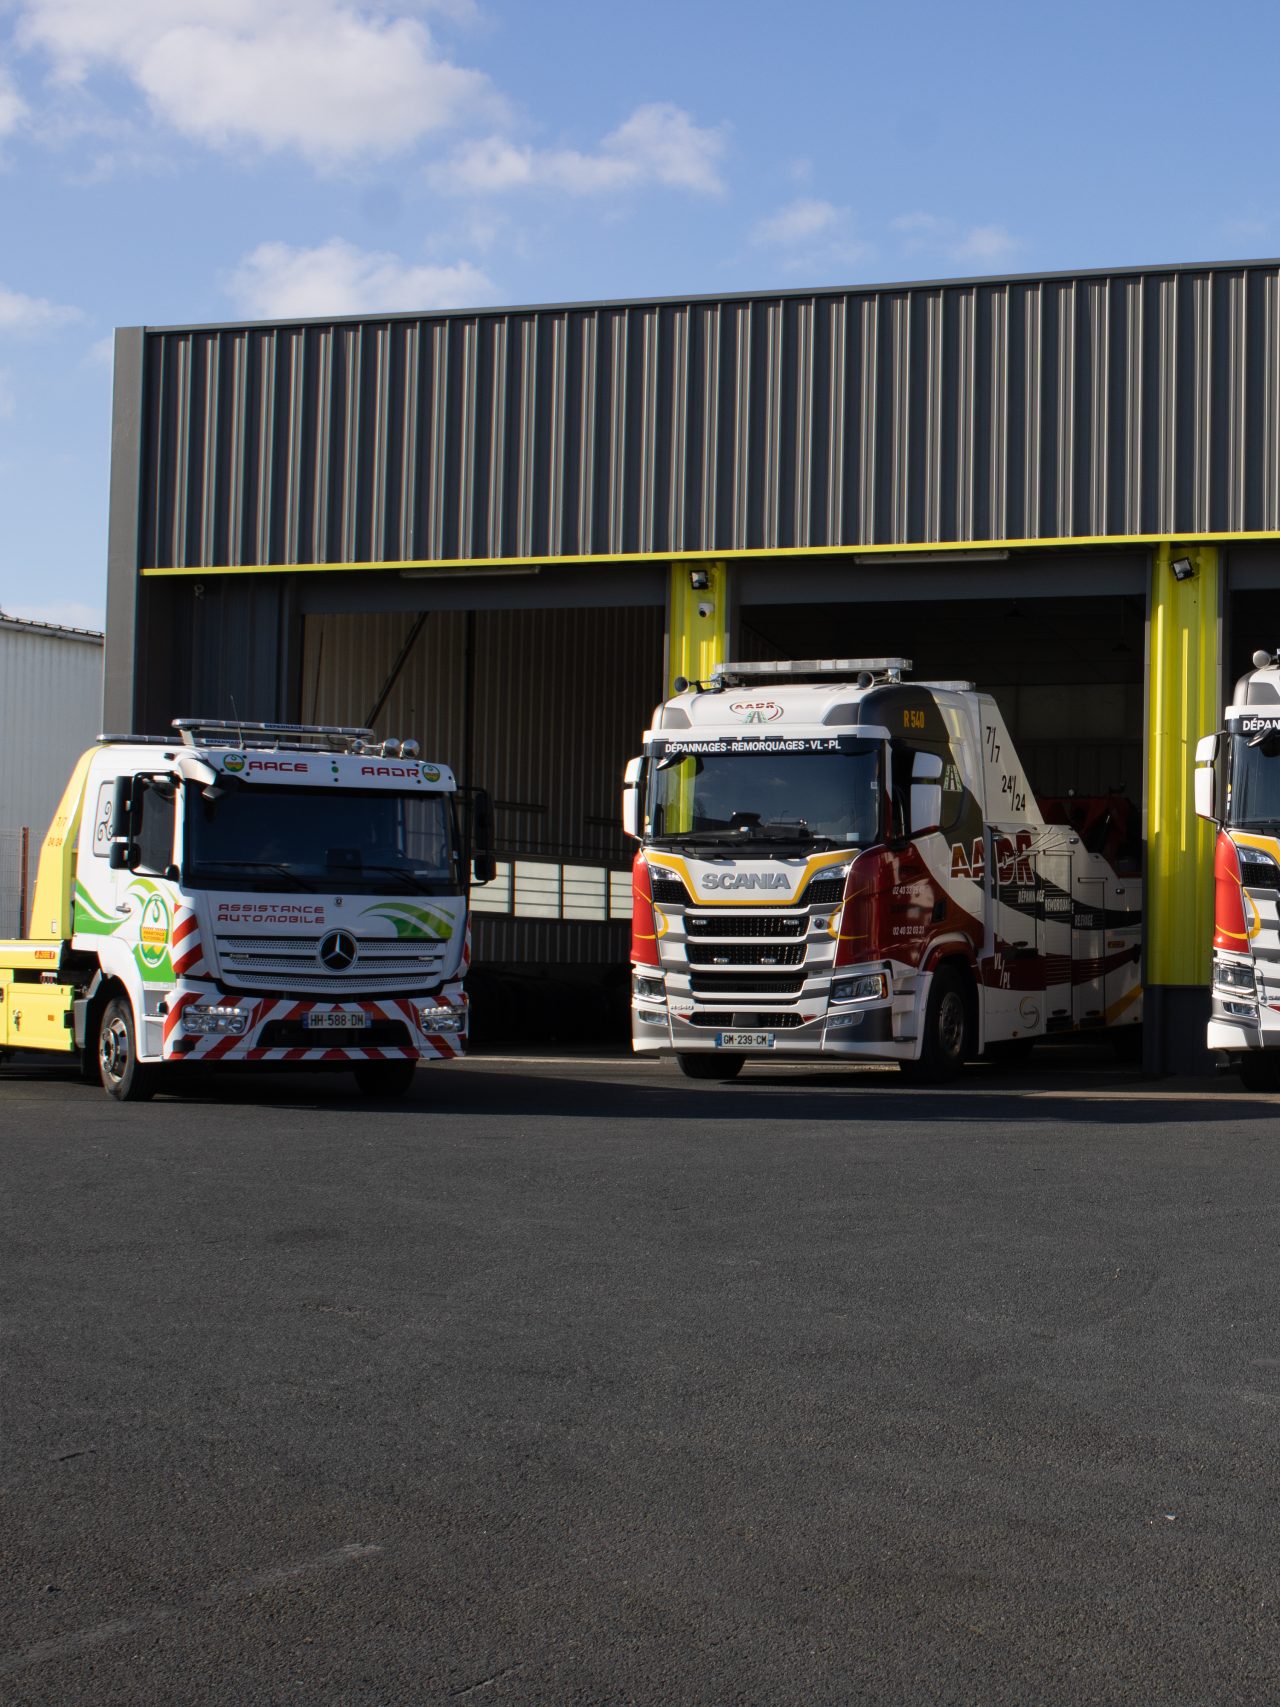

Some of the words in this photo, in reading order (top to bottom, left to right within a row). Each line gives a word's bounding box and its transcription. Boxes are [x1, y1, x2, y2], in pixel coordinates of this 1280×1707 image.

[734, 702, 775, 710] AADR
[903, 710, 910, 728] R
[910, 710, 925, 729] 540
[249, 762, 309, 773] AACE
[361, 766, 419, 778] AADR
[701, 873, 791, 890] SCANIA
[218, 903, 325, 914] ASSISTANCE
[217, 914, 325, 924] AUTOMOBILE
[723, 1034, 767, 1045] GM-239-CM
